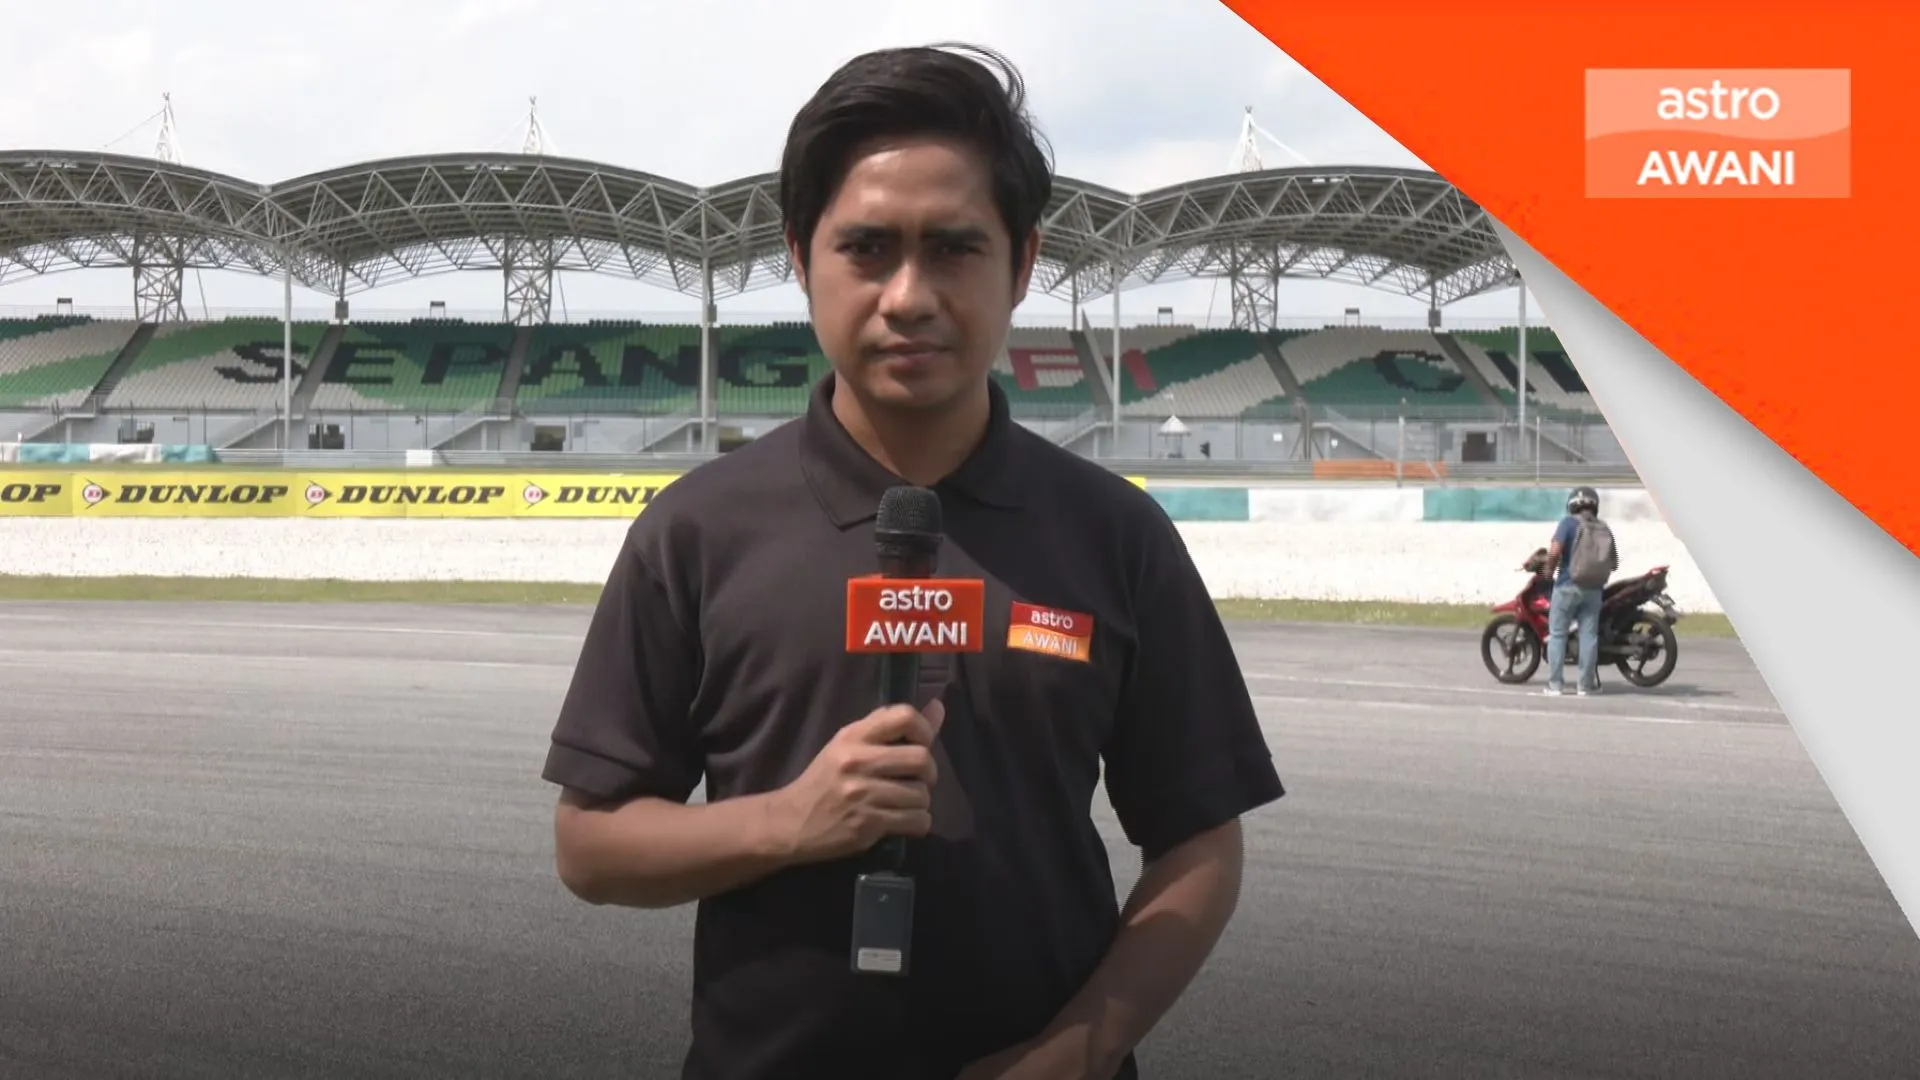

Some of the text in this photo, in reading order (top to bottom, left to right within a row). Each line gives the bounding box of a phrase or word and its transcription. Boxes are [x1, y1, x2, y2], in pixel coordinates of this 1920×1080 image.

[213, 341, 810, 387] SEPANG
[115, 484, 289, 504] DUNLOP
[336, 485, 505, 505] DUNLOP
[878, 584, 953, 611] astro
[1030, 609, 1074, 630] astro
[863, 620, 968, 647] AWANI
[1022, 631, 1078, 656] AWANI
